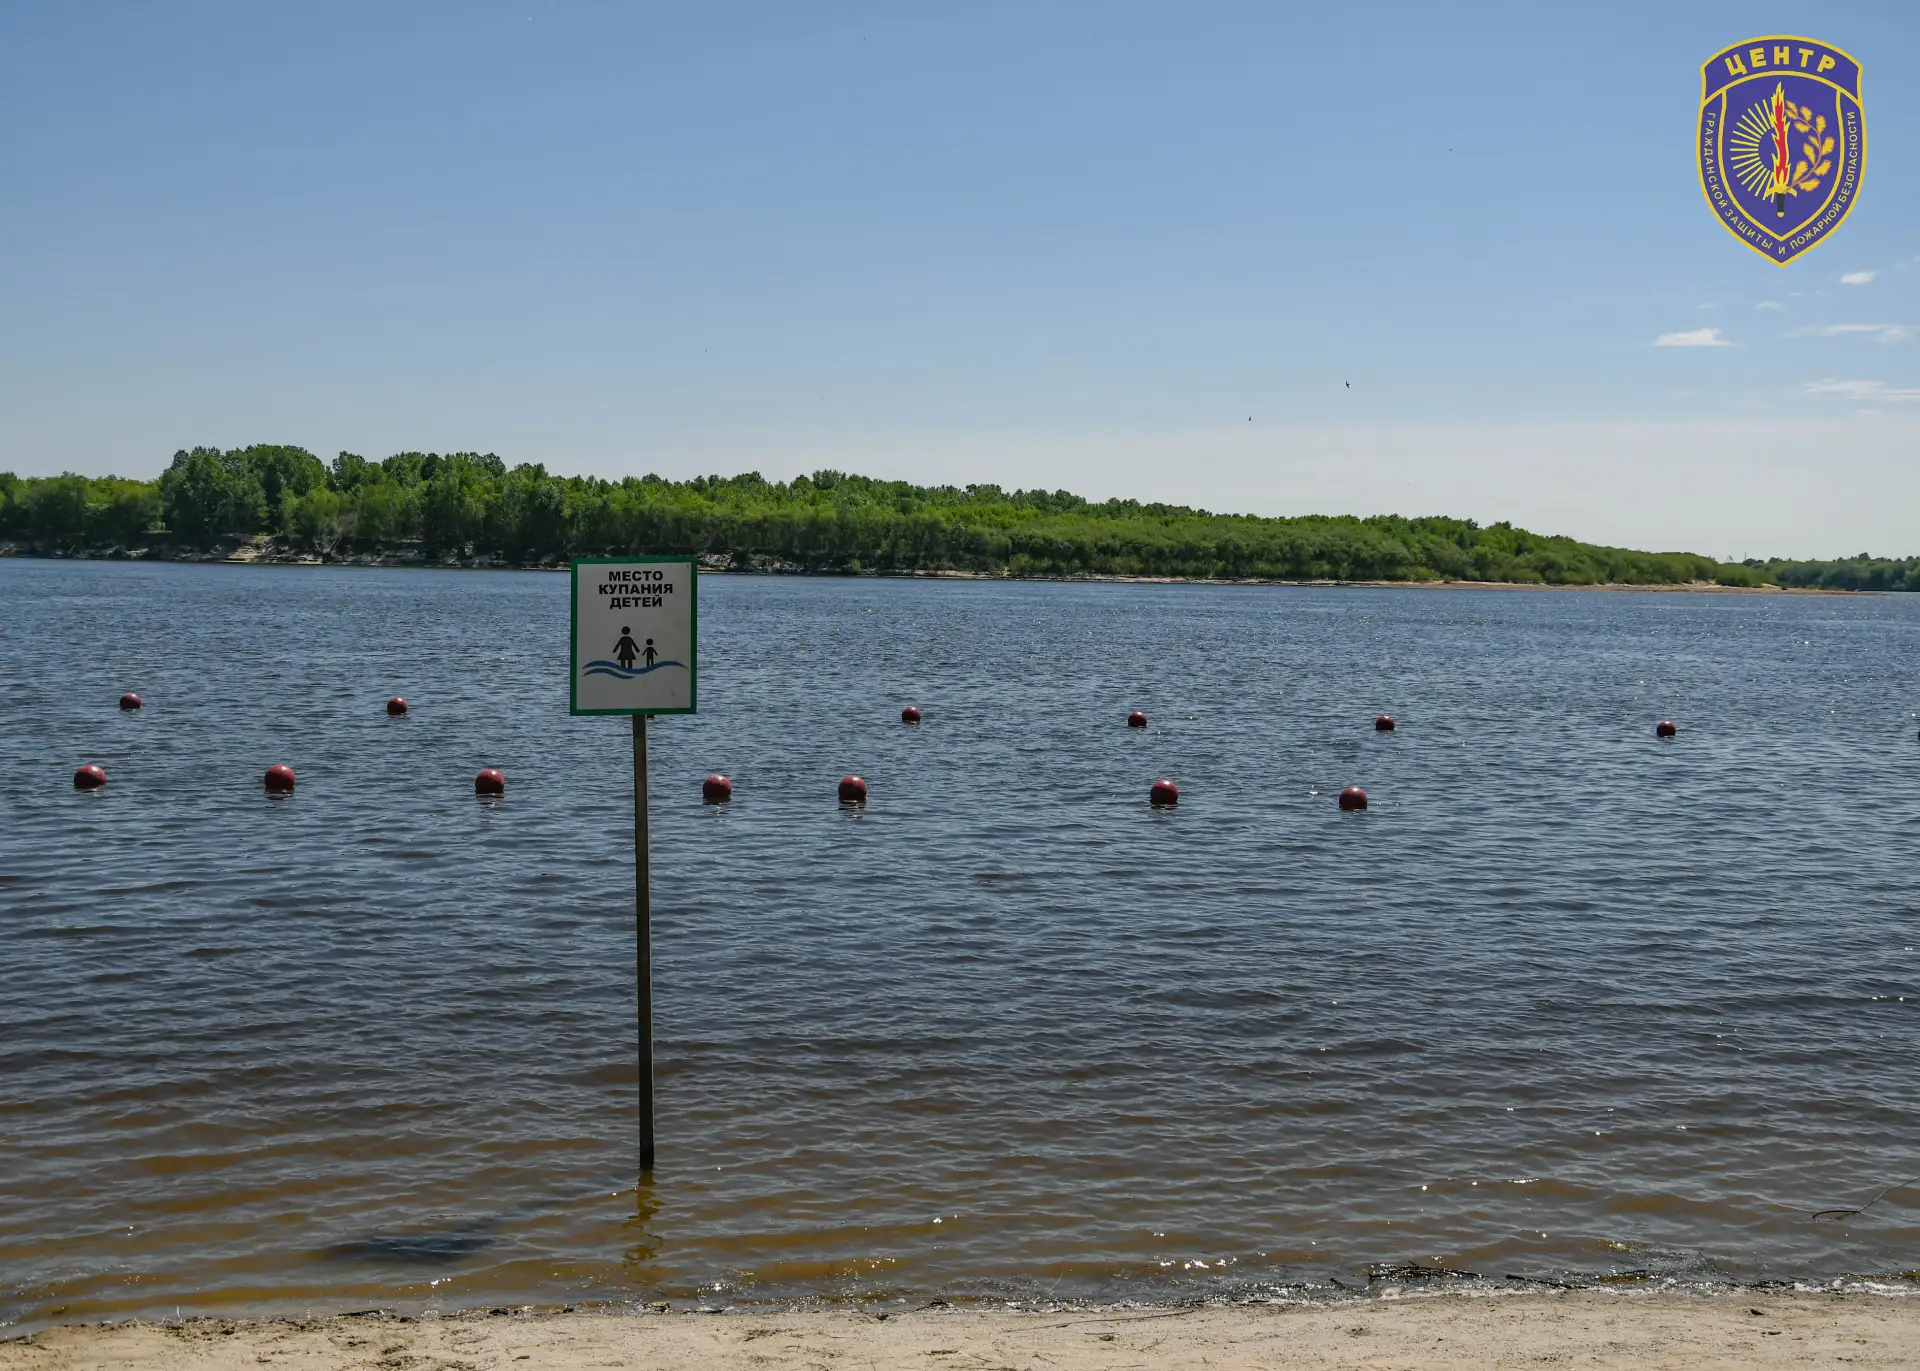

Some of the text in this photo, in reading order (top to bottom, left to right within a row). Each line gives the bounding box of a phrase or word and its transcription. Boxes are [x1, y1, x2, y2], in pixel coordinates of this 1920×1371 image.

[608, 570, 664, 582] МЕСТО
[598, 583, 674, 595] КУПАНИЯ
[609, 594, 663, 610] ДЕТЕЙ
